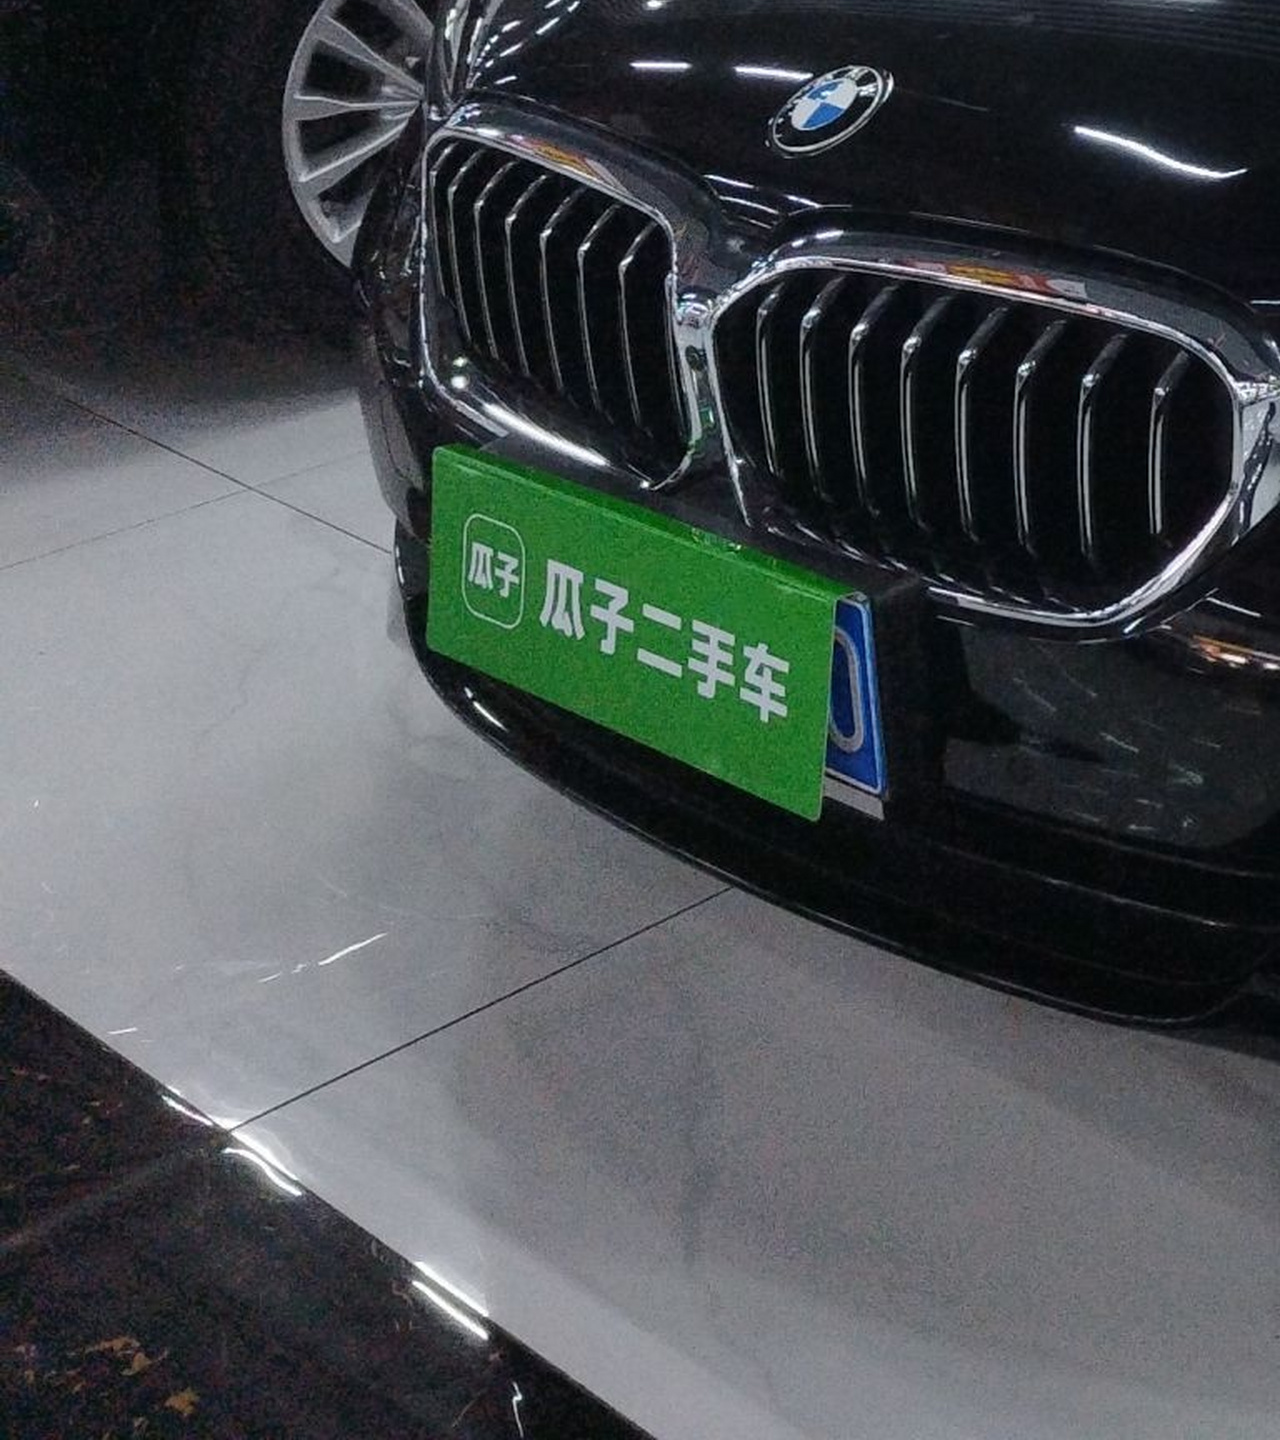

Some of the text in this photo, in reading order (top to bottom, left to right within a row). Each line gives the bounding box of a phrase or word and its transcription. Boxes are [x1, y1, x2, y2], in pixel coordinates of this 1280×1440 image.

[467, 541, 521, 599] 瓜子
[538, 559, 790, 724] 瓜子二手车
